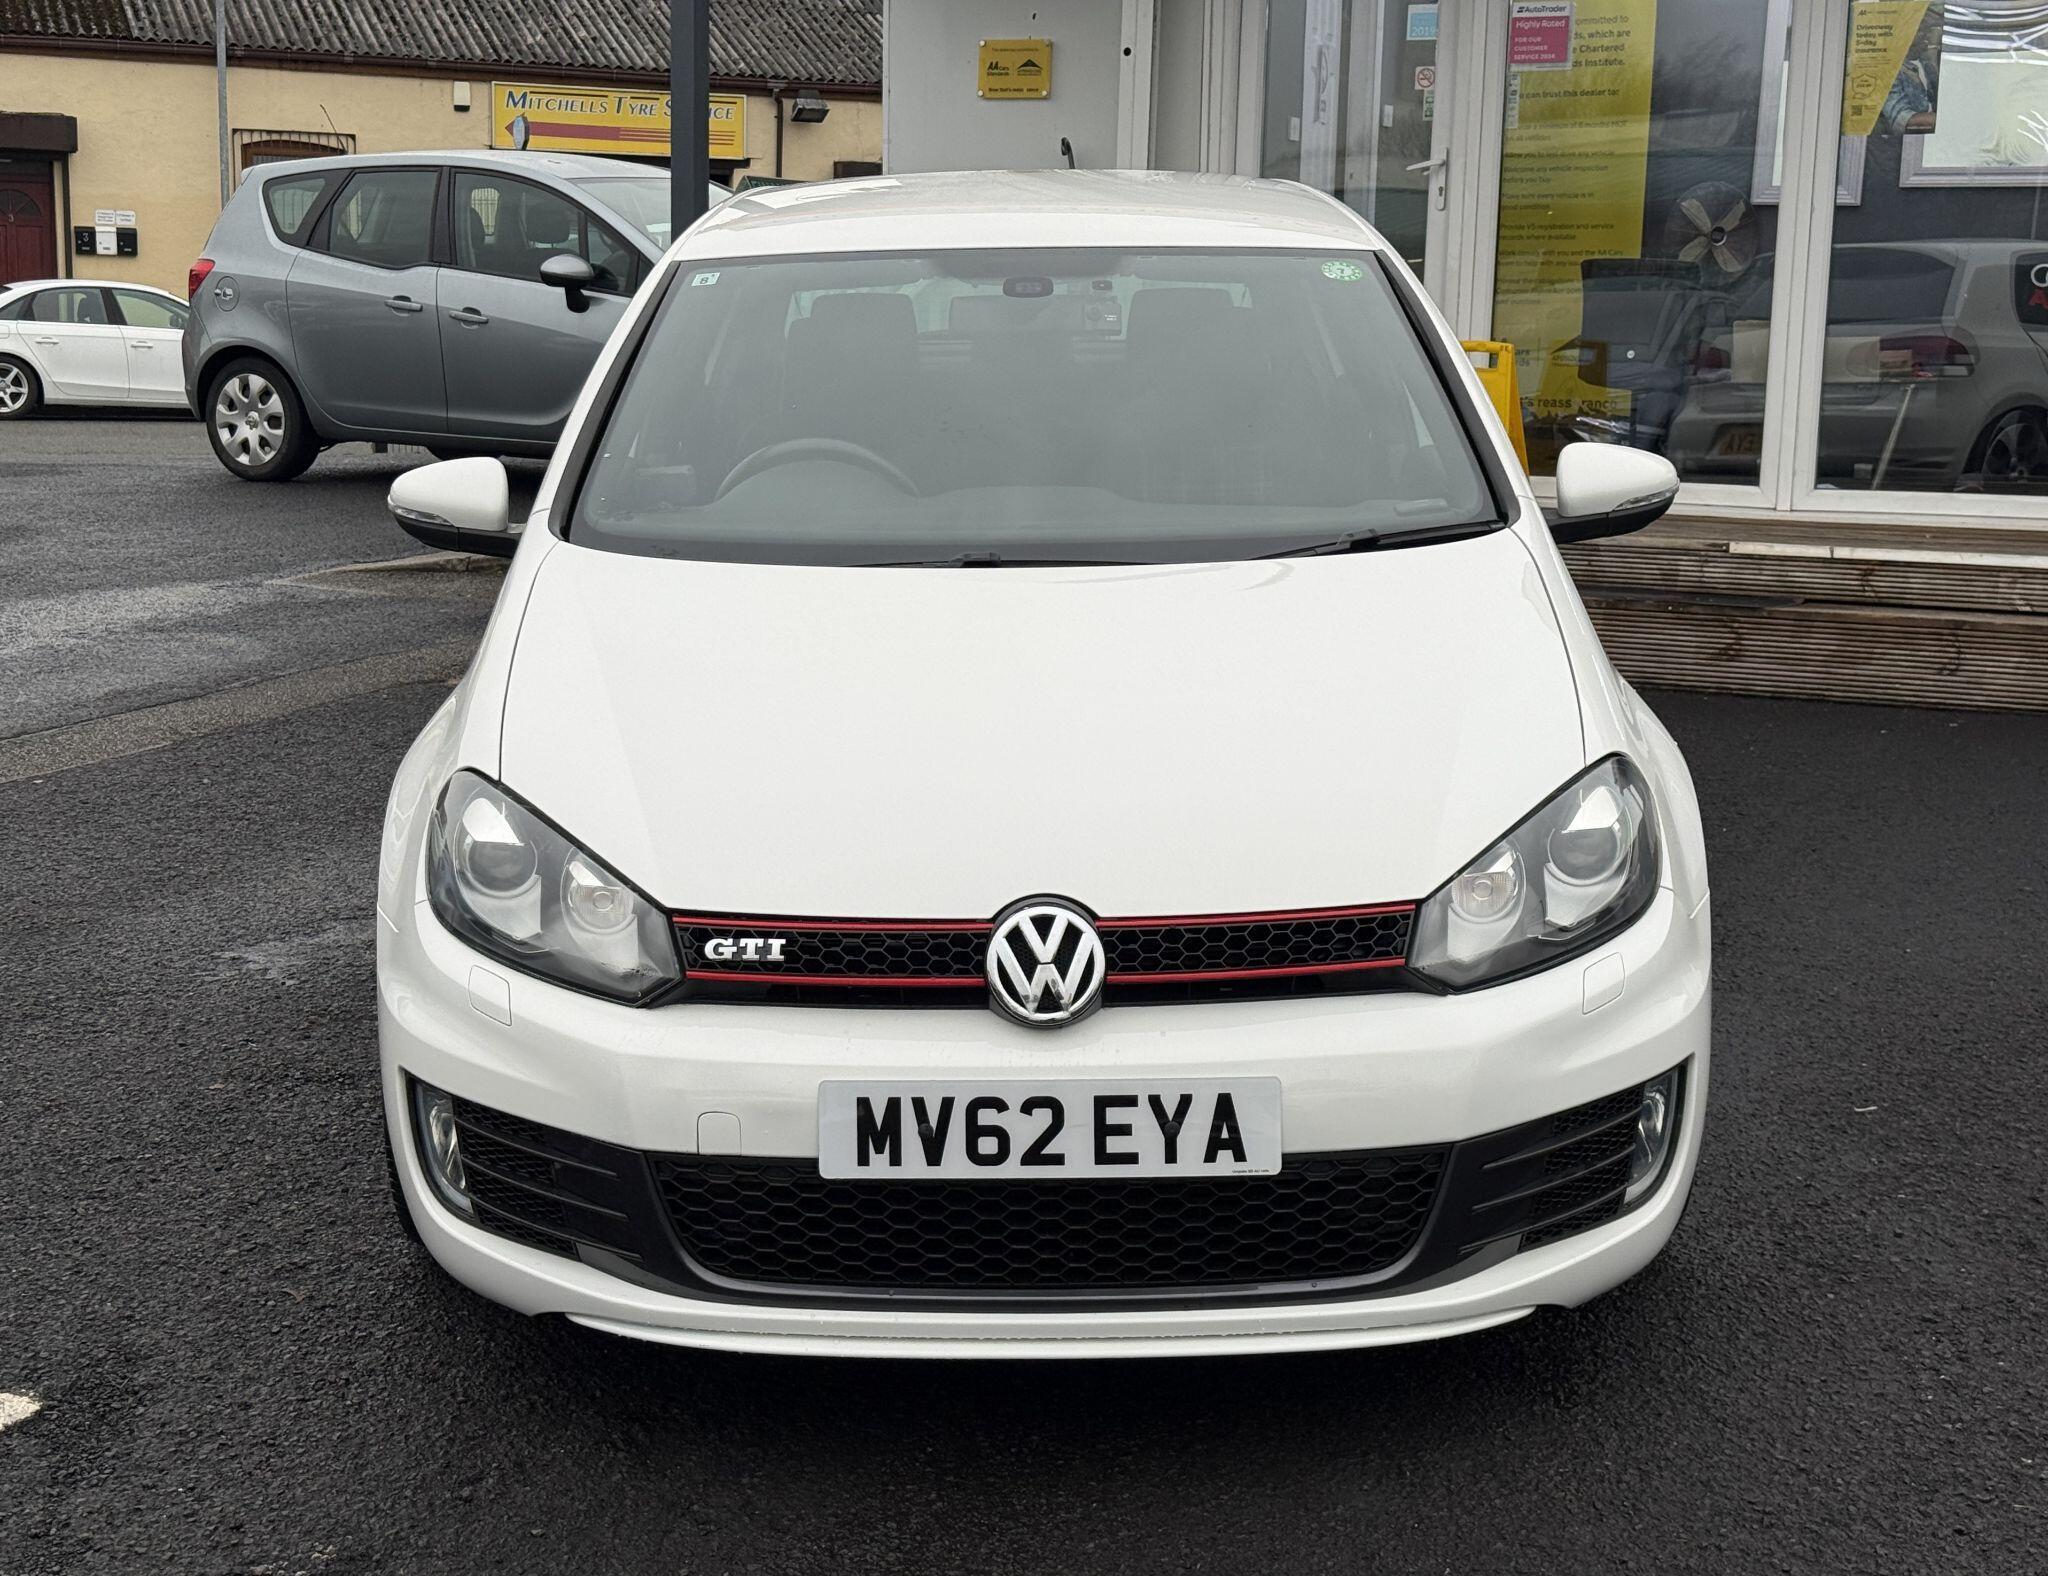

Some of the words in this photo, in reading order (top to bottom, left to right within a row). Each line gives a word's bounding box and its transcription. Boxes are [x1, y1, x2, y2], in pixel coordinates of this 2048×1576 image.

[1524, 5, 1567, 14] AutoTrader
[1516, 20, 1540, 30] Highly
[1541, 19, 1566, 28] Rated
[1575, 15, 1618, 26] ommitted
[1619, 15, 1629, 24] to
[1587, 30, 1614, 39] which
[1616, 30, 1631, 38] are
[1579, 43, 1625, 53] Chartered
[1584, 59, 1625, 67] Institute.
[1525, 91, 1541, 99] can
[1542, 90, 1562, 98] trust
[1562, 89, 1578, 97] this
[1578, 88, 1606, 97] dealer
[505, 89, 608, 114] MITCHELLS
[613, 95, 658, 117] TYRE
[82, 233, 90, 242] 3
[703, 937, 787, 963] GTI
[856, 1095, 1066, 1167] MV62
[1093, 1092, 1248, 1166] EYA
